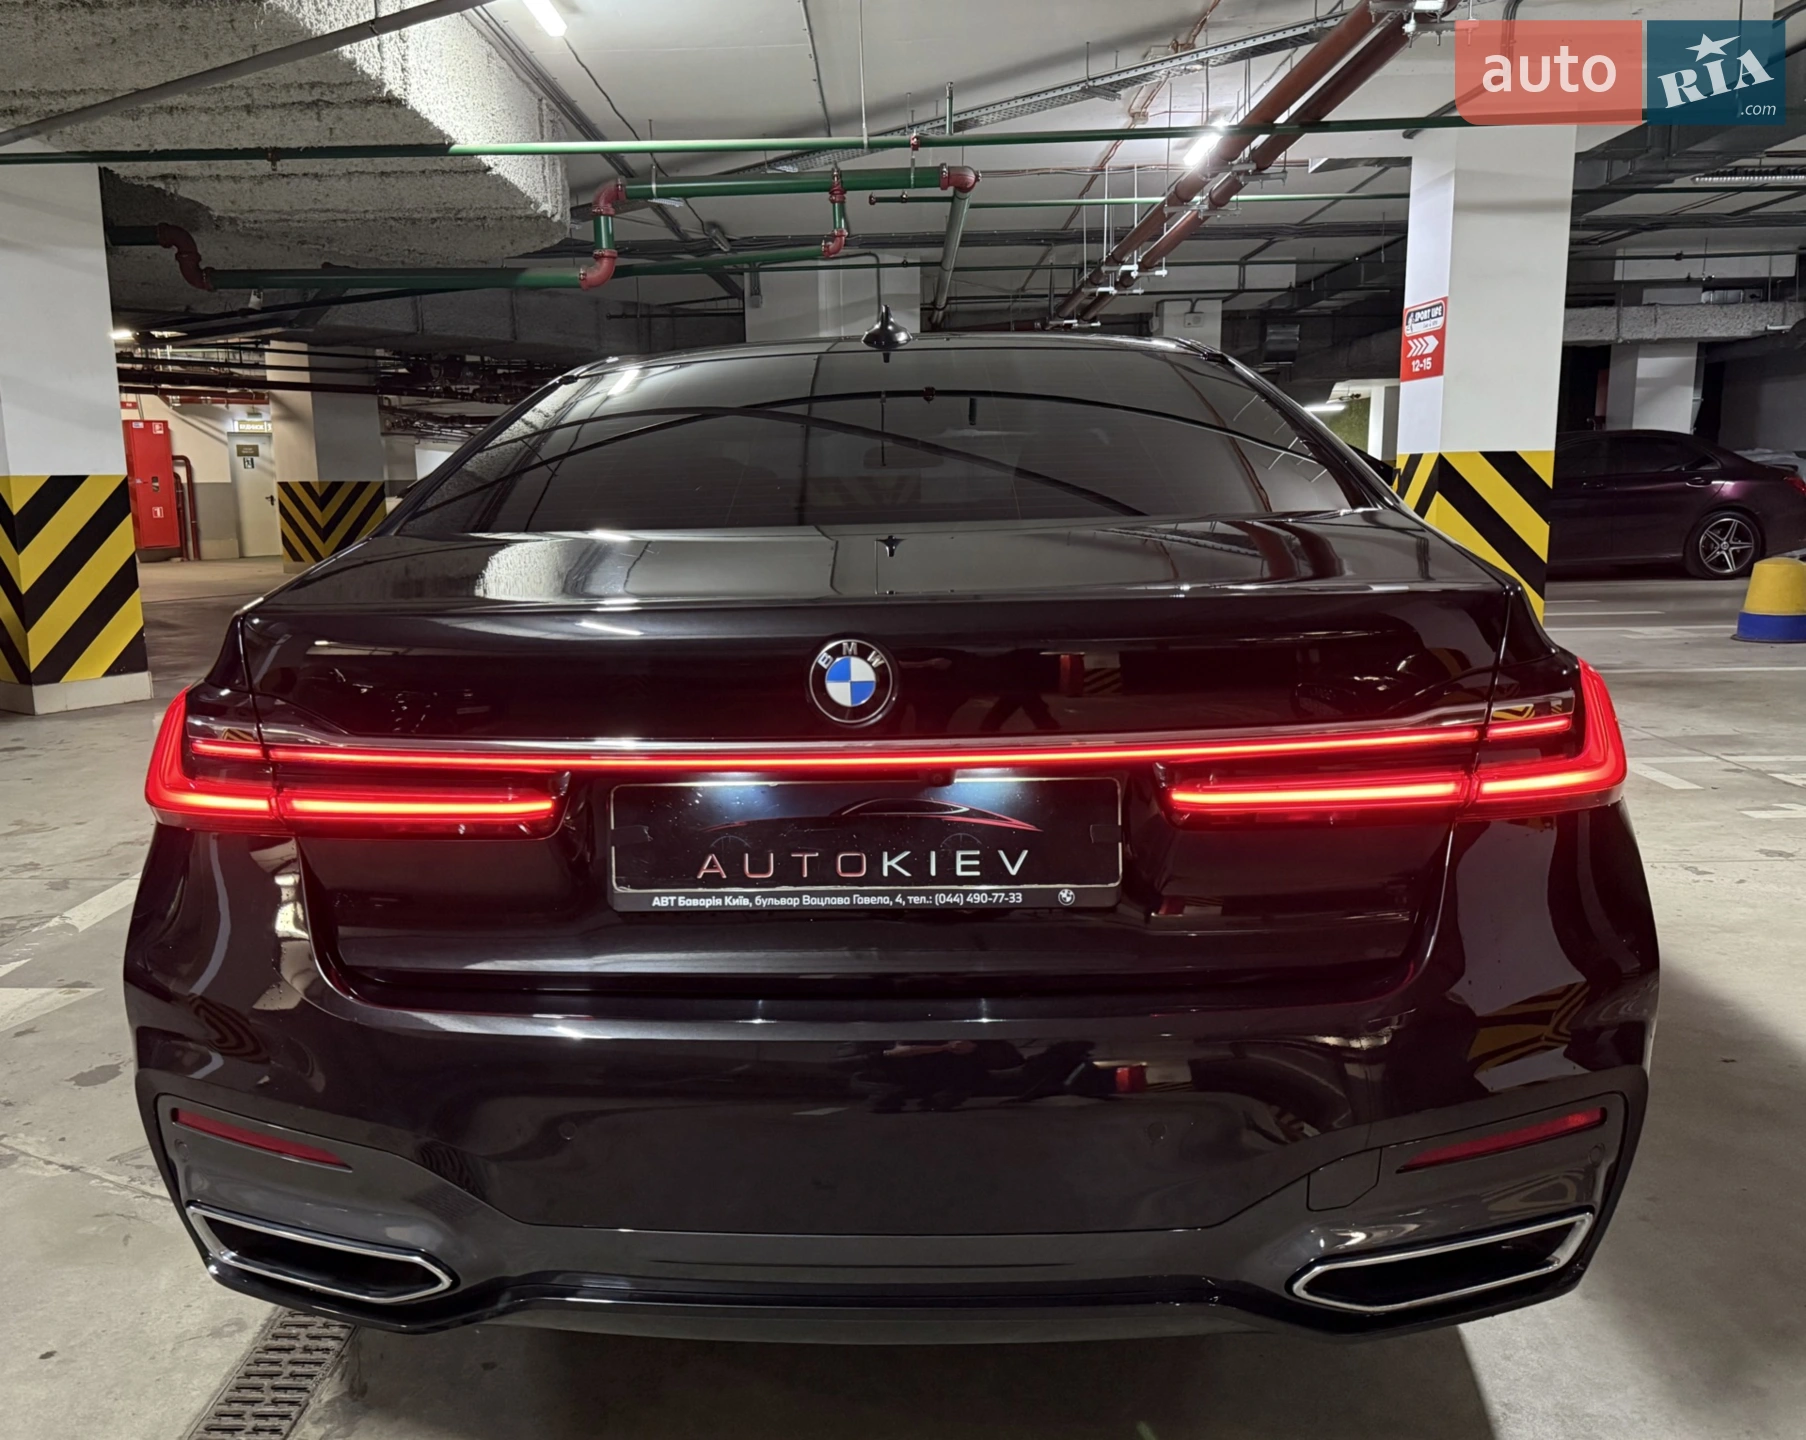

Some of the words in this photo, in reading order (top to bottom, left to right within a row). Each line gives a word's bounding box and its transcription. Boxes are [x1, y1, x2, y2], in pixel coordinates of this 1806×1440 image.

[1414, 308, 1431, 322] SPORT
[1431, 305, 1442, 318] LIFE
[1411, 357, 1432, 372] 12-15
[817, 641, 885, 669] BMW
[697, 849, 1029, 879] AUTOKIEV
[652, 896, 676, 907] АВТ
[678, 896, 722, 908] Баварія
[724, 895, 752, 908] Київ,
[755, 895, 800, 907] бульвар
[802, 895, 849, 907] Вацлава
[853, 894, 893, 906] Гавела,
[895, 894, 905, 906] 4,
[907, 894, 932, 904] тел.:
[935, 893, 964, 906] (044)
[966, 893, 1023, 904] 490-77-33
